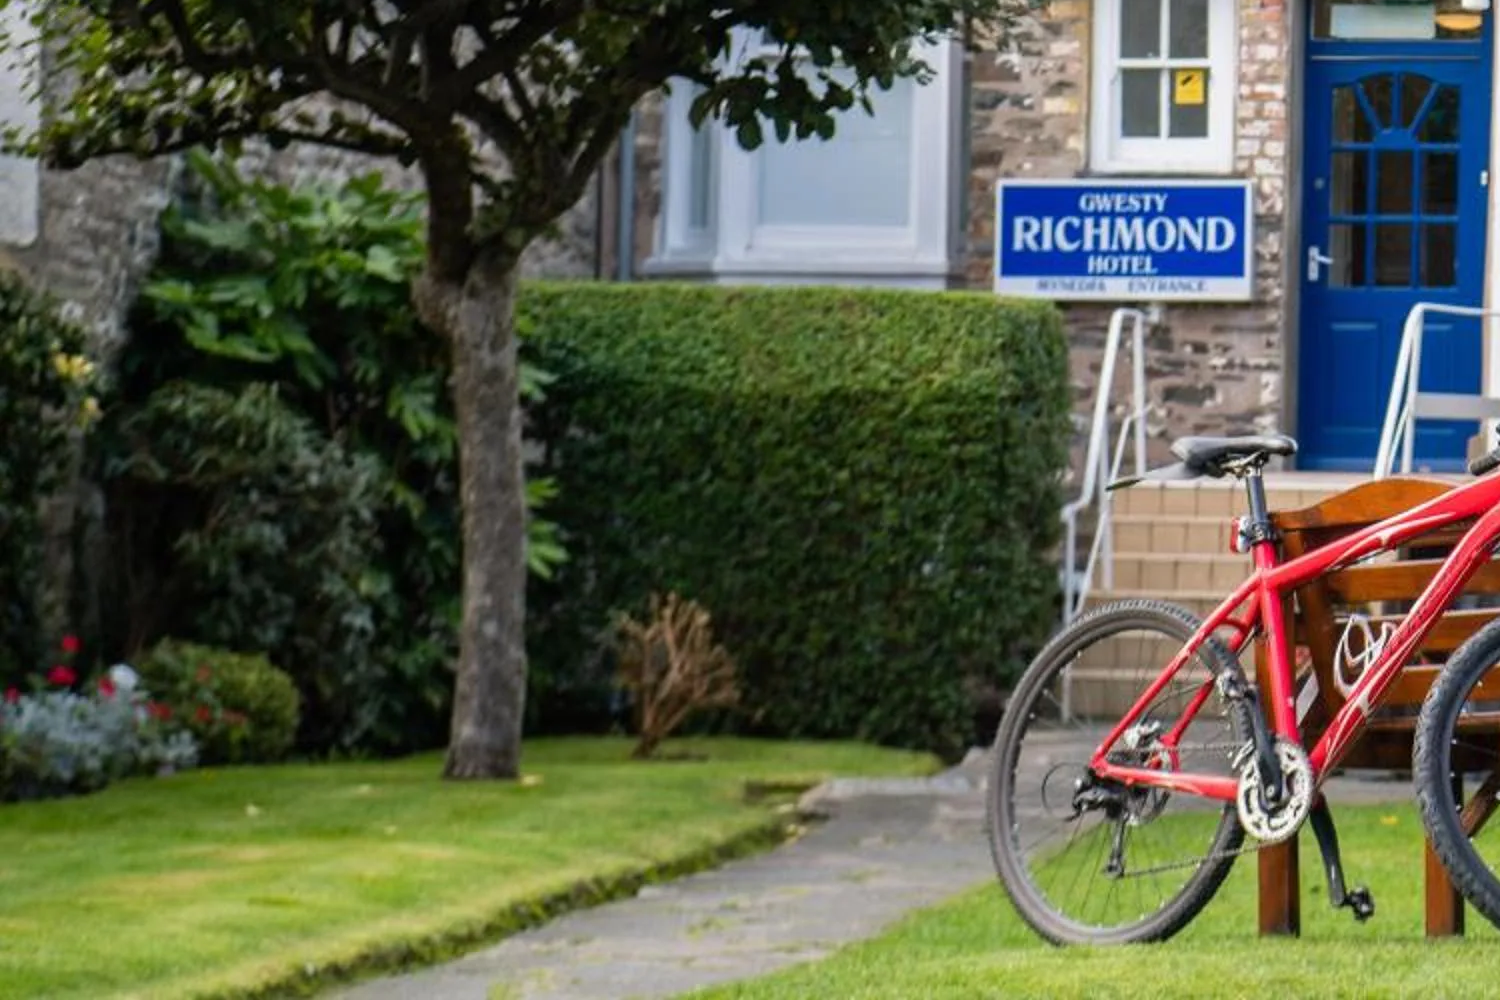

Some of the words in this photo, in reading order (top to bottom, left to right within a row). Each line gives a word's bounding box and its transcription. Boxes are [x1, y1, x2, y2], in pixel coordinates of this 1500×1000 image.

[1079, 192, 1168, 213] GWESTY
[1012, 216, 1237, 252] RICHMOND
[1087, 255, 1158, 275] HOTEL
